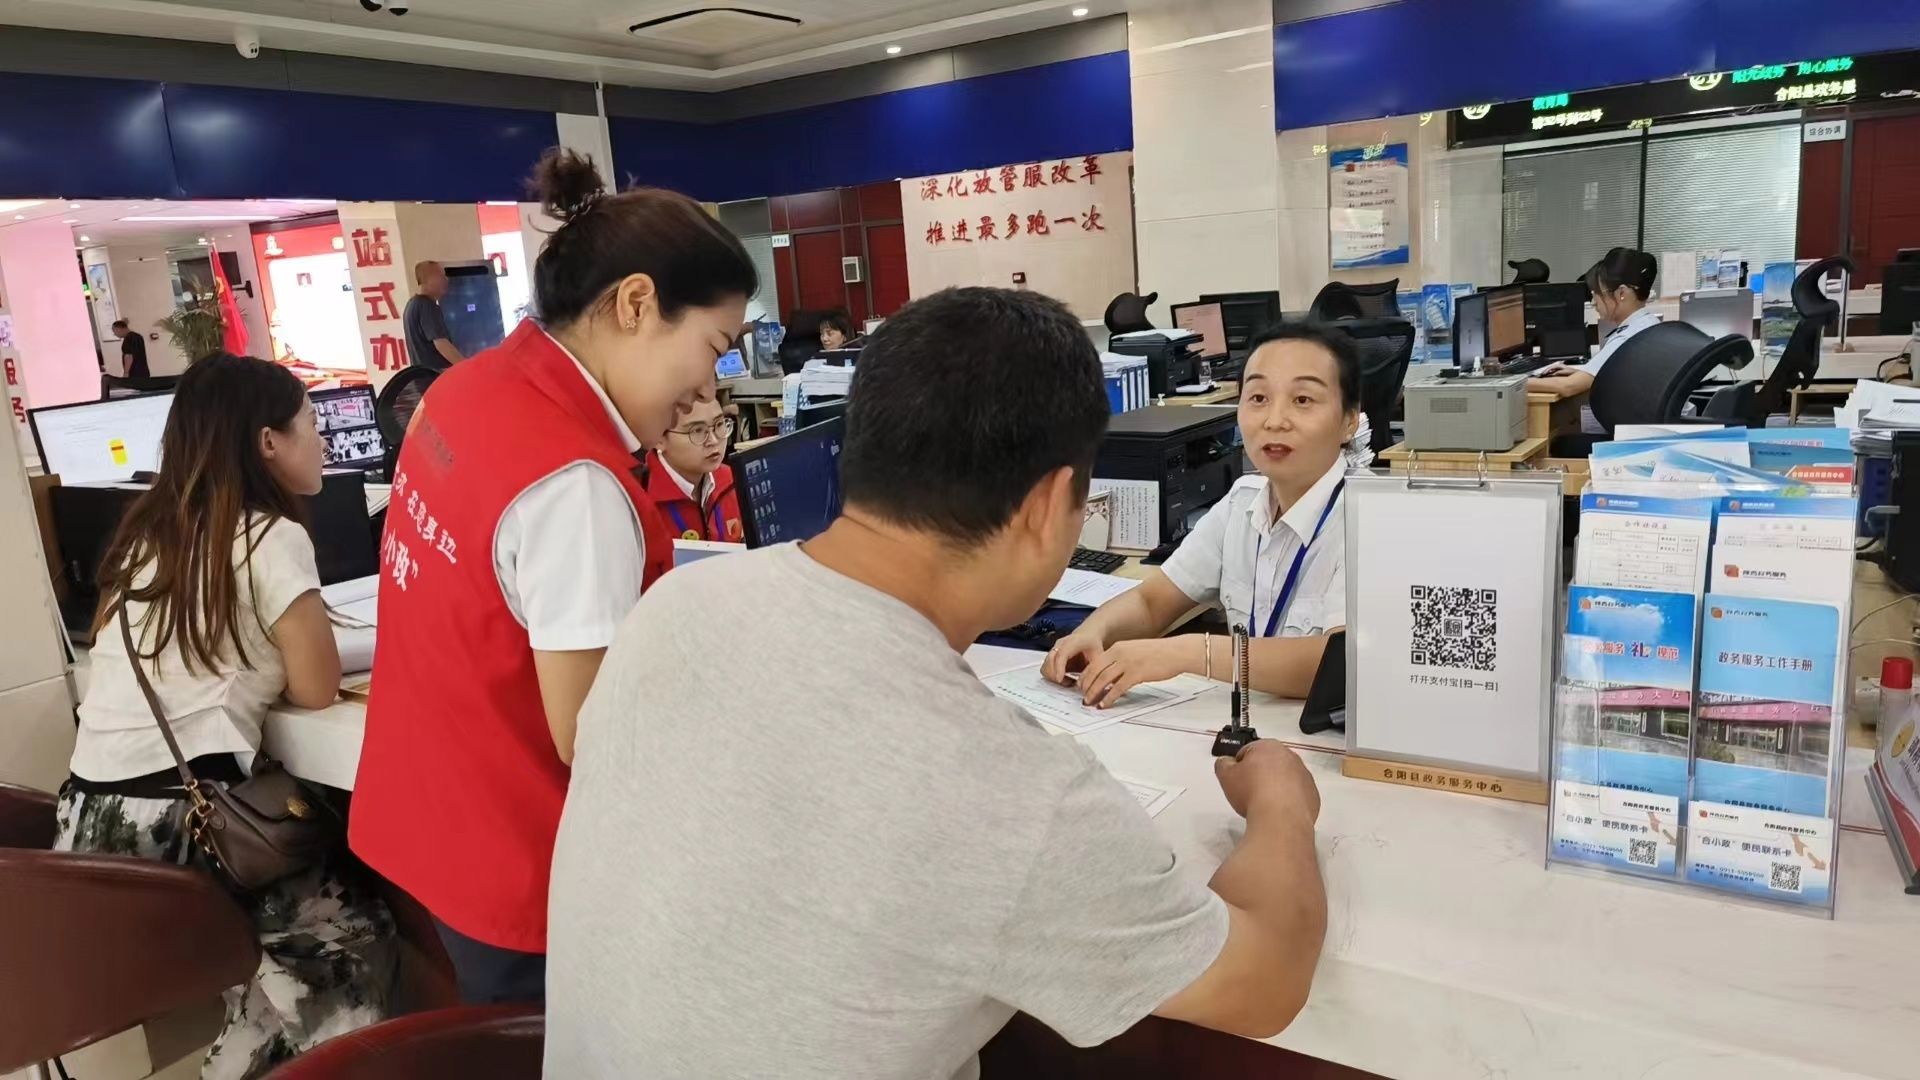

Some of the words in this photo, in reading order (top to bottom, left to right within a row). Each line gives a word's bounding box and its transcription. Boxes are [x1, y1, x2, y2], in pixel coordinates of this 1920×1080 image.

[1809, 127, 1841, 136] 综合协调
[920, 155, 1103, 201] 深化放管服改革
[925, 204, 1106, 246] 推进最多跑一次
[1718, 651, 1813, 672] 政务服务工作手册
[1383, 767, 1503, 793] 合阳县政务服务中心
